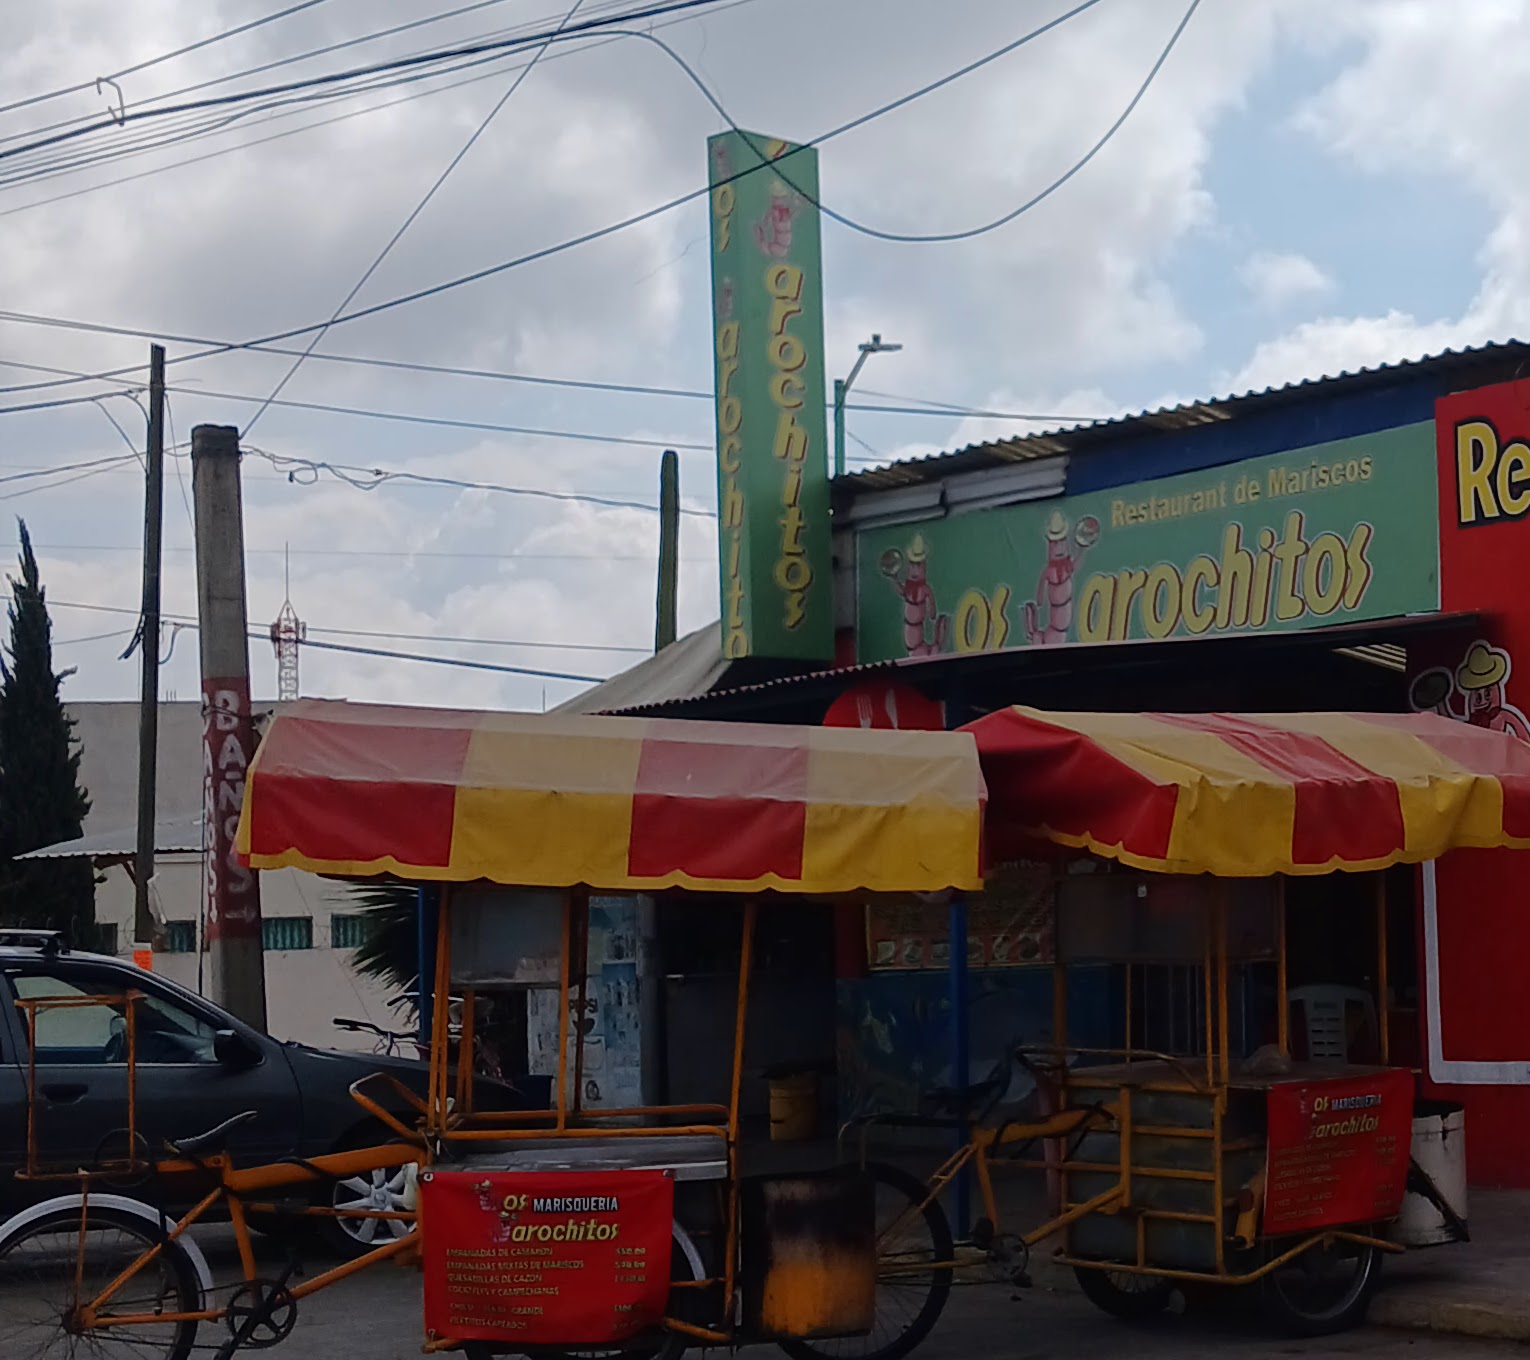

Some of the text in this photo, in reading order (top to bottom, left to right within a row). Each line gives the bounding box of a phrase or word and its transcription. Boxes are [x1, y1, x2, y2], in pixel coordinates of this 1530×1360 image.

[1111, 455, 1373, 528] Restaurant de Mariscos
[533, 1195, 619, 1213] MARISQUERIA
